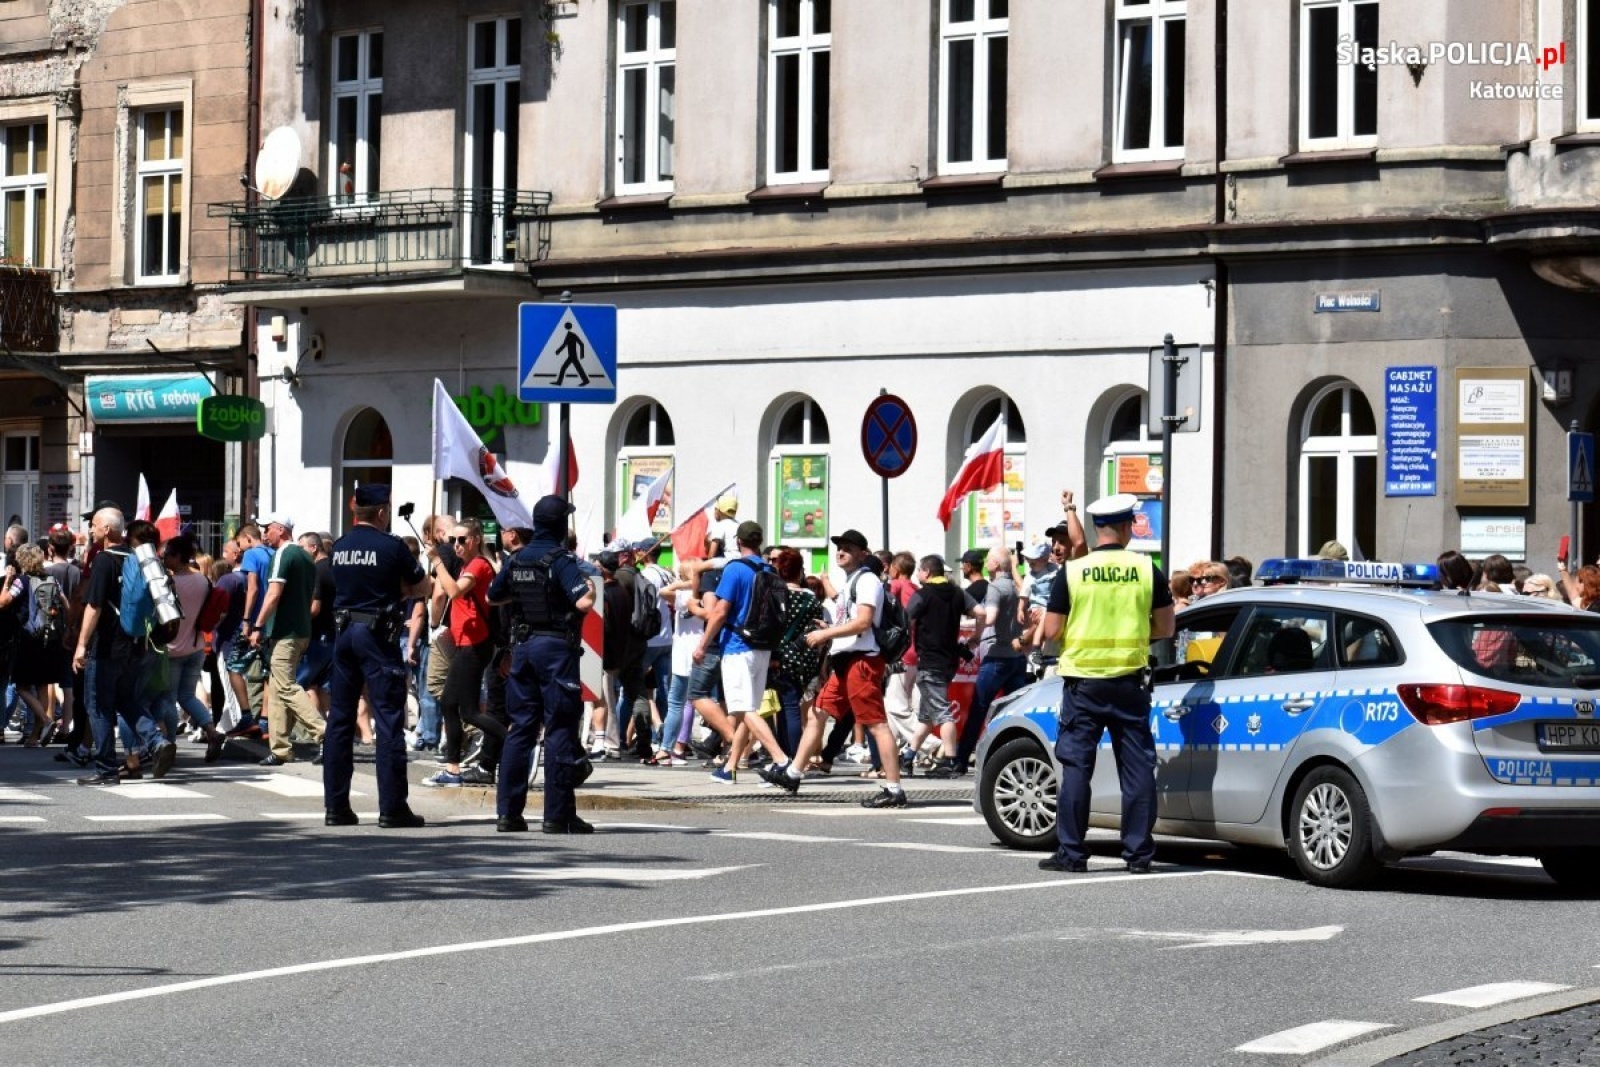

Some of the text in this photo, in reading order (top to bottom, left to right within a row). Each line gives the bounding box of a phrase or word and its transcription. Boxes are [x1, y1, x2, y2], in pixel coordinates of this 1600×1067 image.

[1390, 371, 1433, 381] GABINET
[1390, 381, 1433, 393] MASAŻU
[125, 389, 157, 411] RTG
[208, 404, 261, 424] żabka
[332, 550, 377, 566] POLICJA
[512, 570, 536, 581] POLICJA
[1082, 566, 1140, 583] POLICJA
[1347, 563, 1399, 580] POLICJA
[1365, 702, 1398, 722] R173
[1547, 726, 1577, 745] HPP
[1498, 760, 1553, 777] POLICJA
